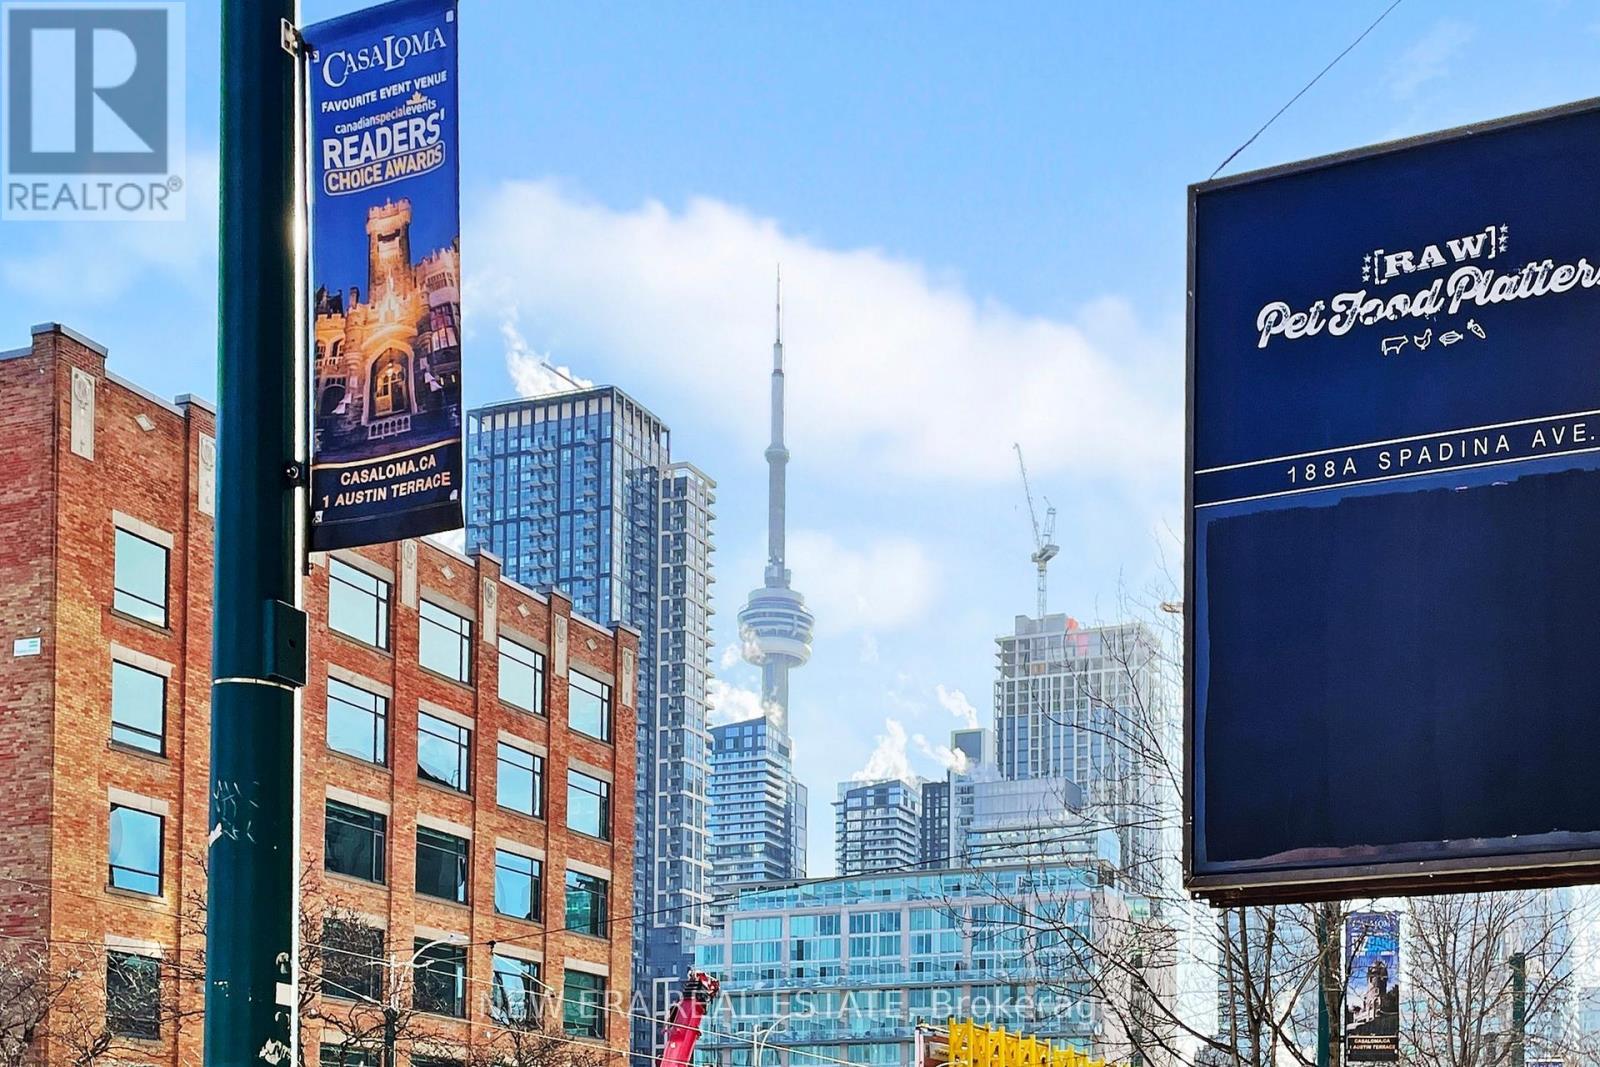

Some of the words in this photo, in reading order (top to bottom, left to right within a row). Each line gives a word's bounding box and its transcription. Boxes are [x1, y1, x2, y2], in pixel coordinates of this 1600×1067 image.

[321, 91, 377, 113] FAVOURITE
[379, 81, 412, 101] EVENT
[414, 70, 448, 91] VENUE
[327, 163, 383, 192] CHOICE
[385, 144, 443, 179] AWARDS
[1256, 299, 1326, 349] Pet
[1328, 278, 1445, 336] Food
[340, 453, 437, 486] CASALOMA.CA
[1287, 456, 1357, 484] 188A
[1378, 434, 1510, 471] SPADINA
[1531, 422, 1596, 448] AVE.
[322, 494, 329, 508] 1
[334, 488, 387, 508] AUSTIN
[390, 471, 452, 498] TERRACE
